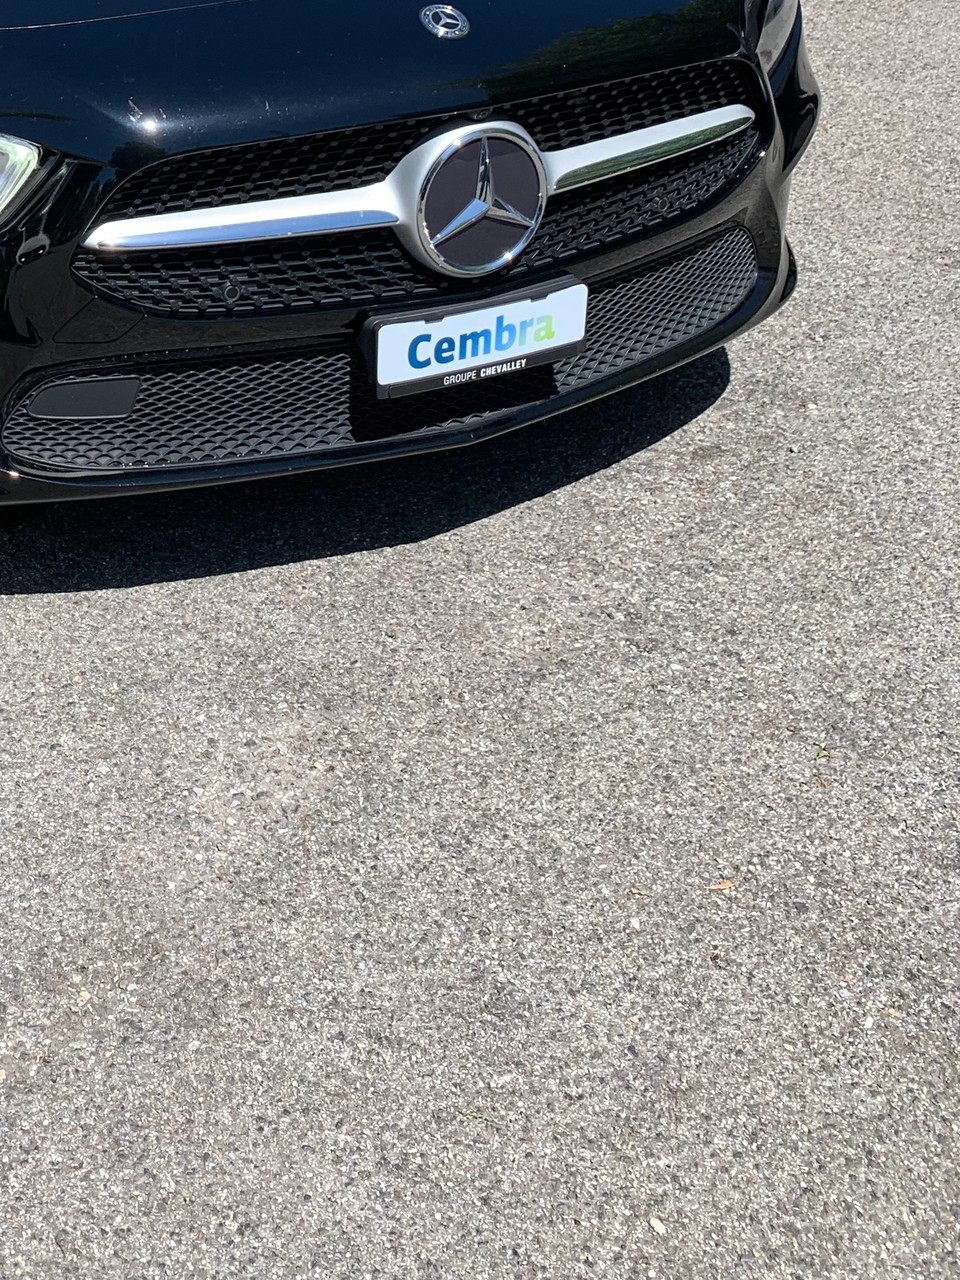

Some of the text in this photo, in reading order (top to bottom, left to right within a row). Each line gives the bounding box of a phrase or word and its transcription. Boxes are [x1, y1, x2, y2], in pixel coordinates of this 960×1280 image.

[407, 314, 556, 370] Cembra
[443, 358, 527, 386] GROUPE CHEVALLEY
